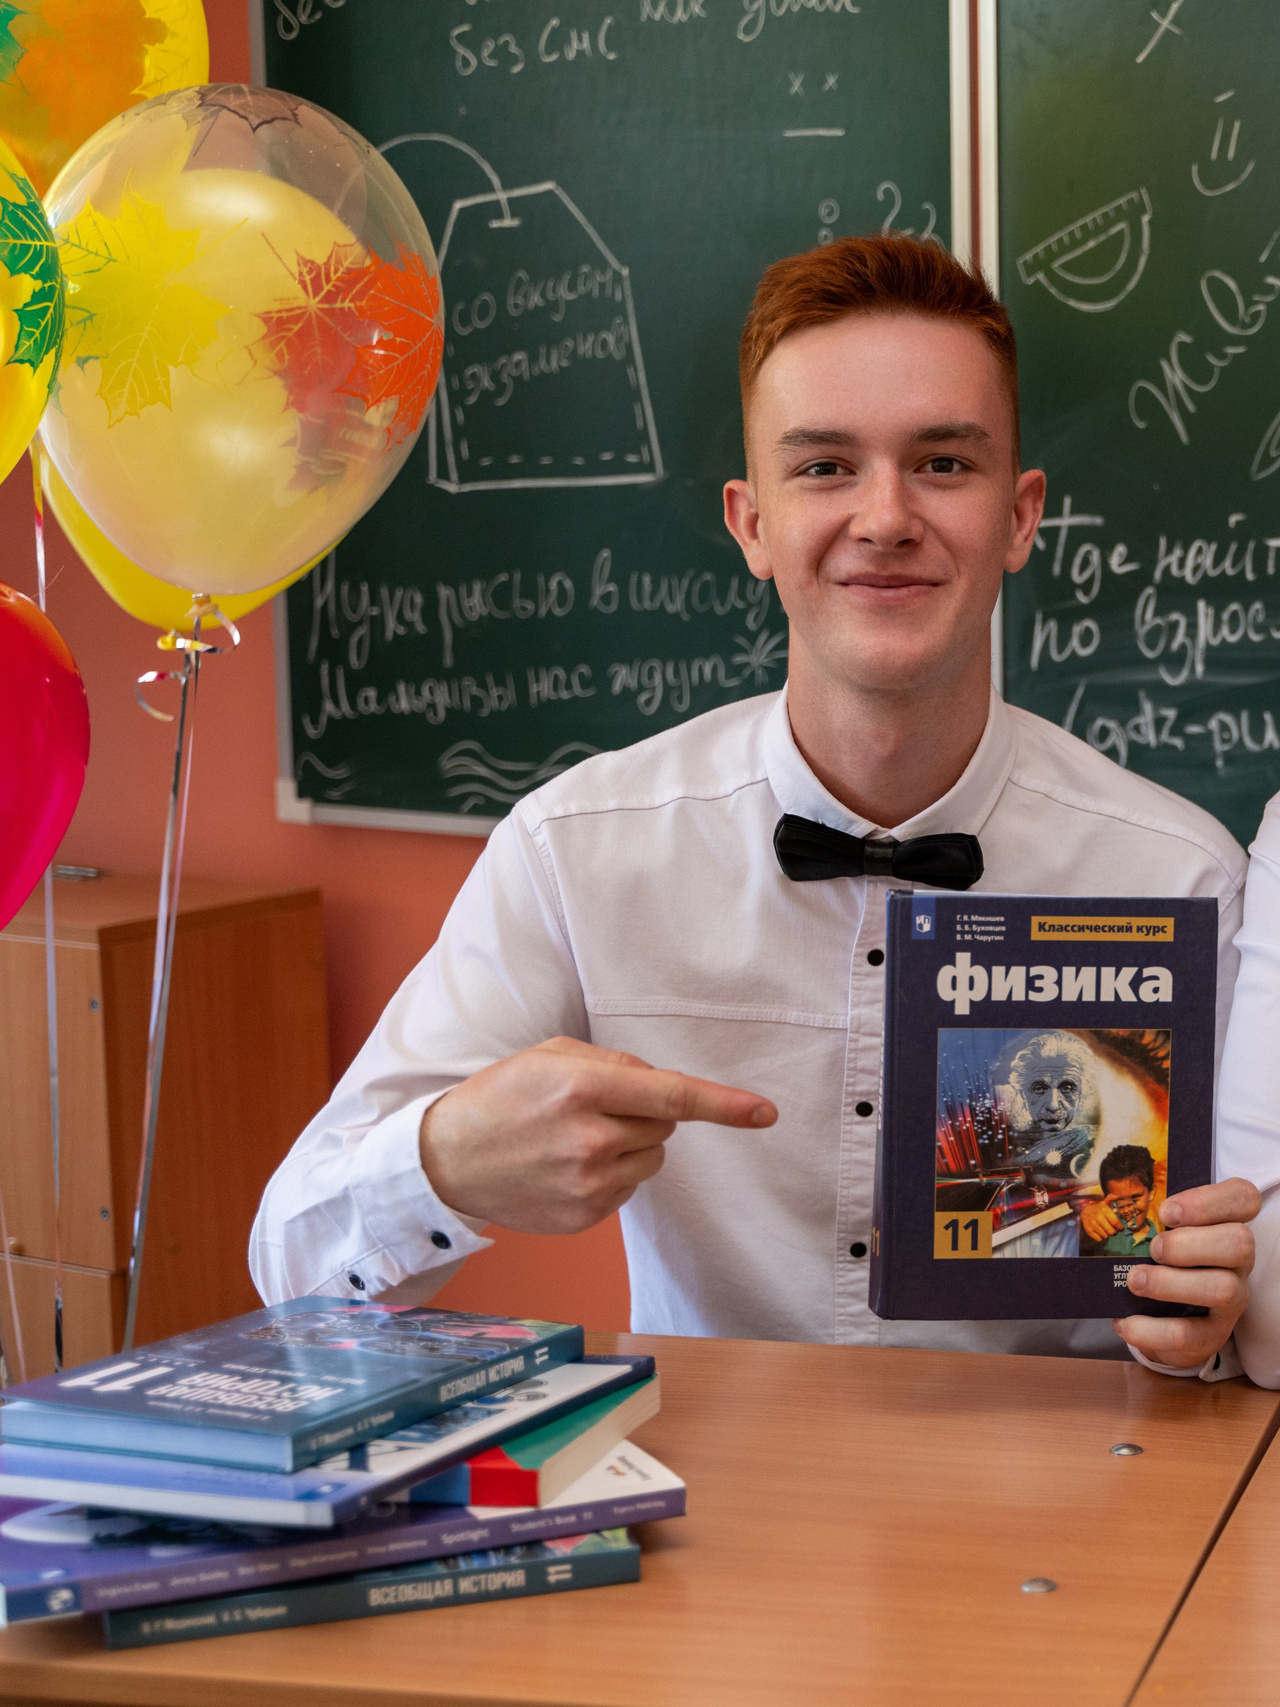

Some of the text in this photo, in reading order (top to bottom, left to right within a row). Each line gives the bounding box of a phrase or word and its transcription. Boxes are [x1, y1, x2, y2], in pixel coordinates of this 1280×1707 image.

[450, 22, 525, 76] без
[451, 290, 498, 337] со
[1029, 609, 1101, 671] по
[526, 662, 598, 713] нас
[1037, 921, 1168, 936] Классический курс
[936, 952, 1174, 1015] физика
[943, 1218, 979, 1251] 11
